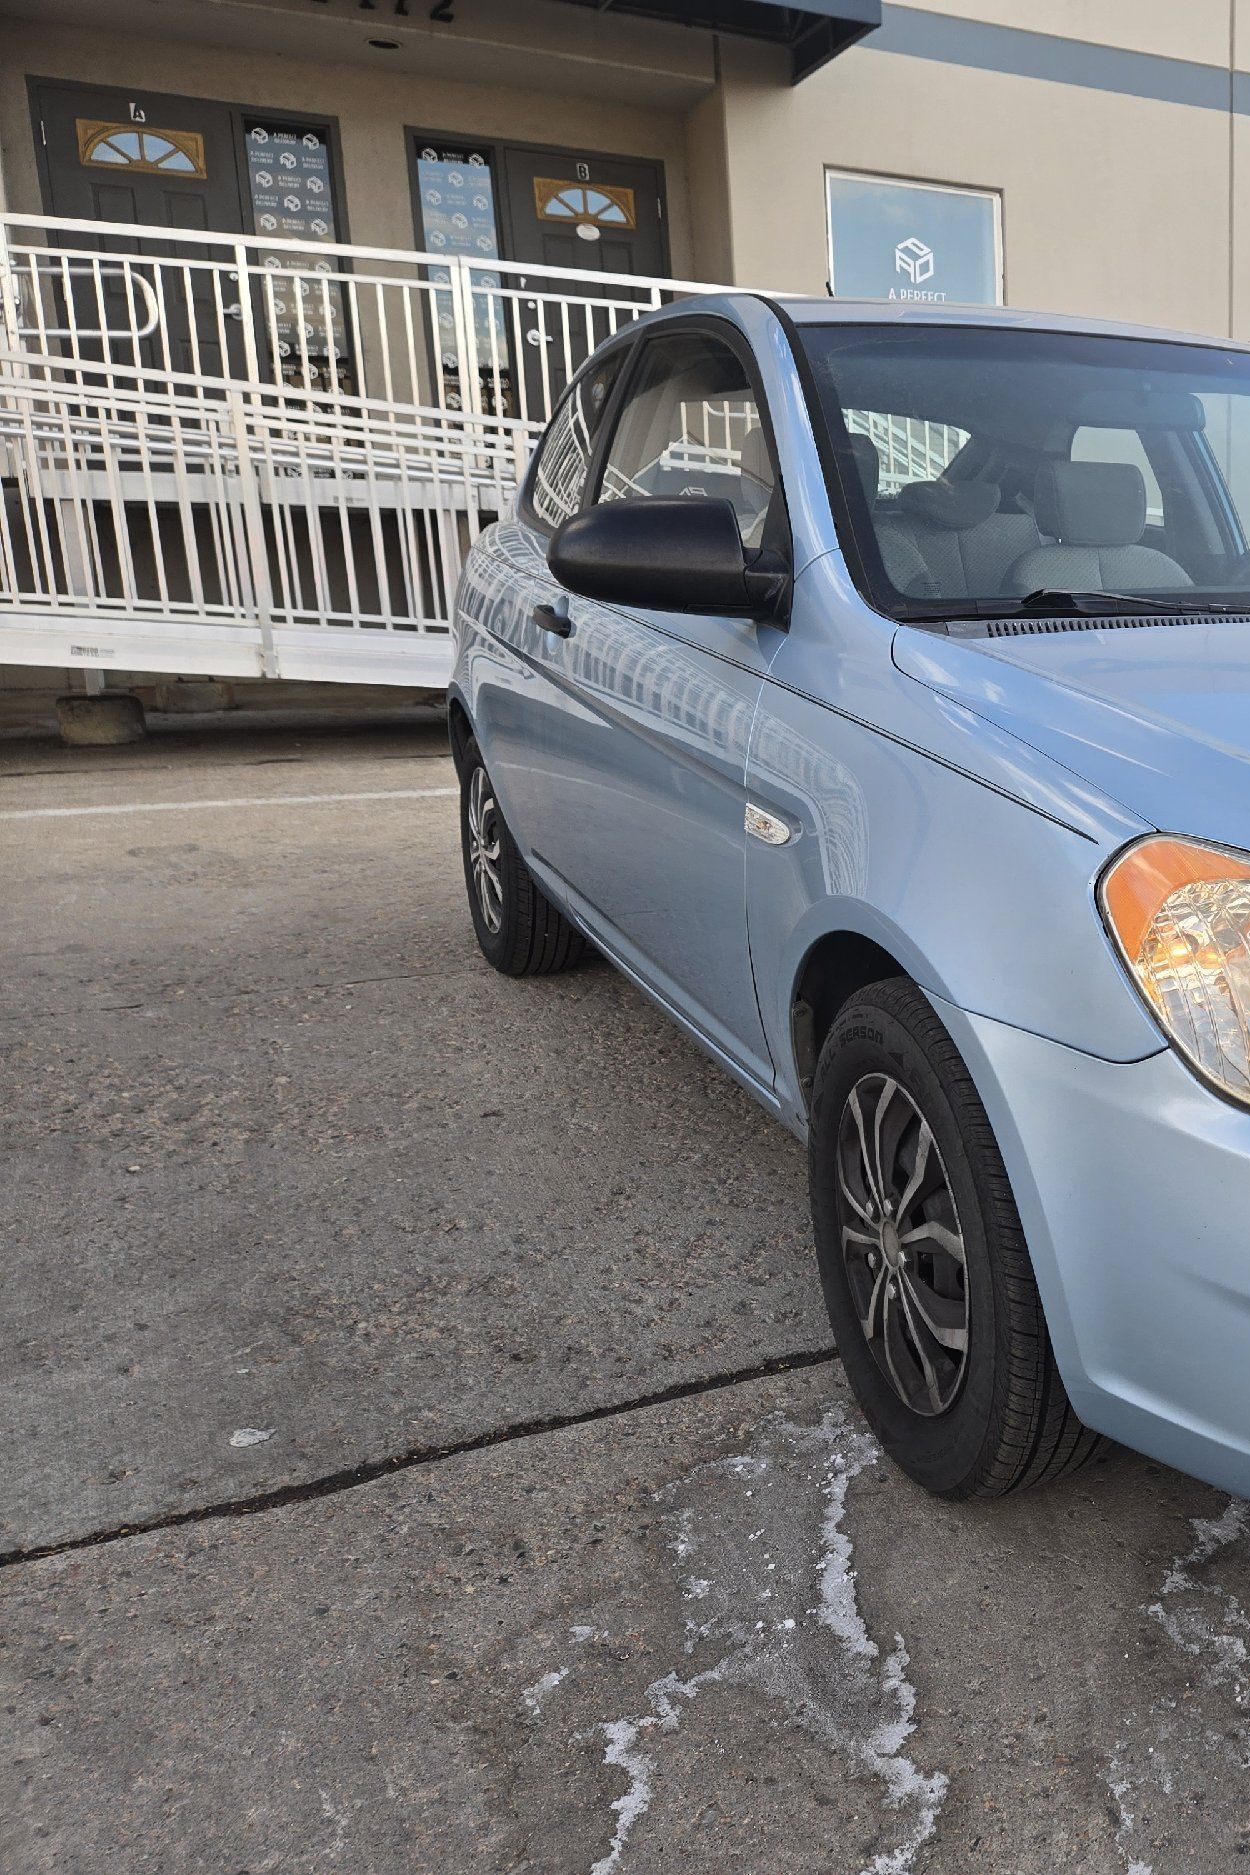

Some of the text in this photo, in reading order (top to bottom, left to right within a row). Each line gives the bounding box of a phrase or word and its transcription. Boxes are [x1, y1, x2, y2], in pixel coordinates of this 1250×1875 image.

[578, 164, 588, 180] B
[888, 287, 947, 302] A PERFECT
[838, 1025, 885, 1048] SEASON
